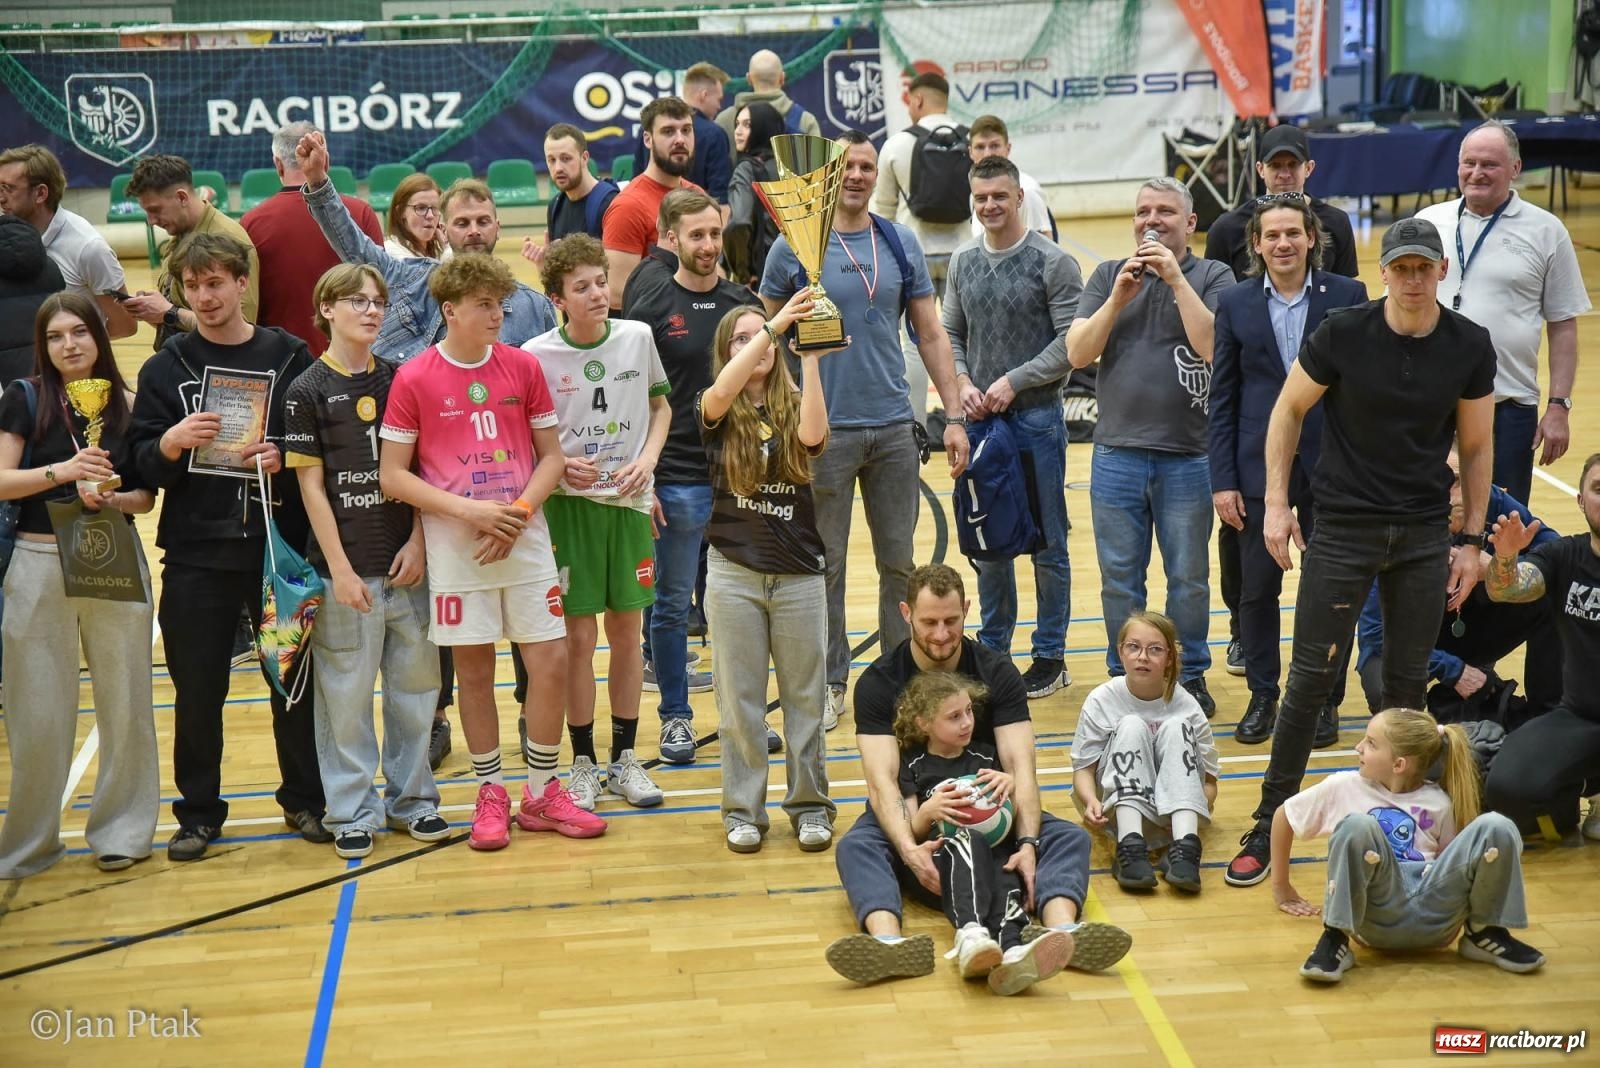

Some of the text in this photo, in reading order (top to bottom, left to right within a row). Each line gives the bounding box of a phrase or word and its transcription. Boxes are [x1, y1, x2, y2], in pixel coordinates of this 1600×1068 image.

[573, 70, 687, 122] OSi
[955, 70, 1218, 103] VANESSA
[207, 81, 464, 136] RACIBÓRZ
[592, 386, 609, 413] 4
[470, 410, 498, 441] 10
[571, 420, 631, 438] VISON
[457, 448, 517, 466] VISON
[435, 594, 463, 627] 10
[1565, 604, 1589, 620] KARL
